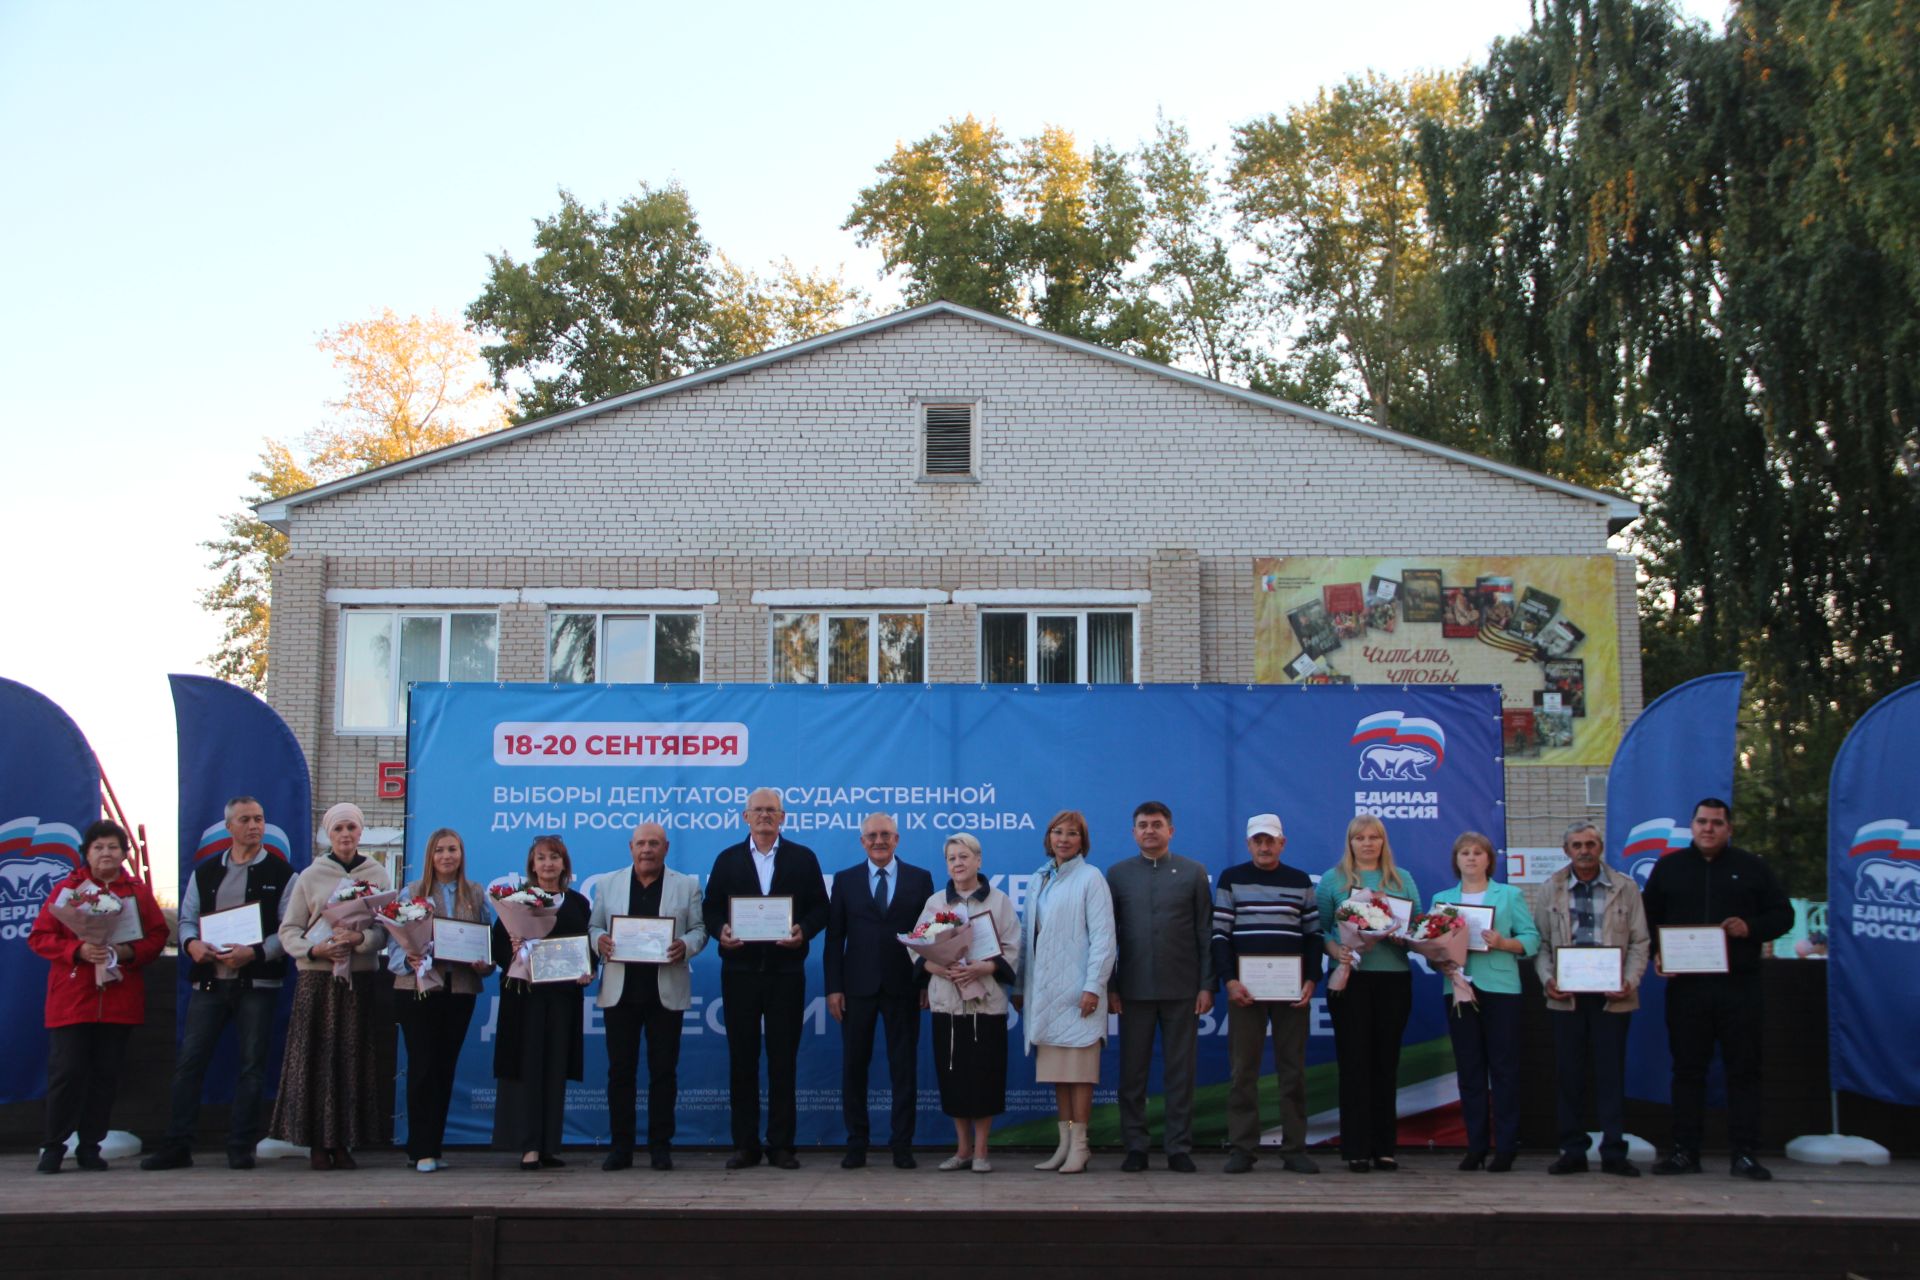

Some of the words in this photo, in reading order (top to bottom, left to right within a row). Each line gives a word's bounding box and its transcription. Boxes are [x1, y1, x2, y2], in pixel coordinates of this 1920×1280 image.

[504, 735, 577, 755] 18-20
[585, 735, 738, 755] СЕНТЯБРЯ
[494, 786, 601, 804] ВЫБОРЫ
[608, 786, 749, 806] ДЕПУТАТОВ
[771, 783, 996, 806] ОСУДАРСТВЕННОЙ
[1354, 791, 1438, 805] ЕДИНАЯ
[491, 812, 567, 831] ДУМЫ
[575, 809, 739, 830] РОССИЙСКОЙ
[906, 813, 927, 830] IX
[933, 812, 1035, 830] СОЗЫВА
[1354, 805, 1439, 819] РОССИЯ
